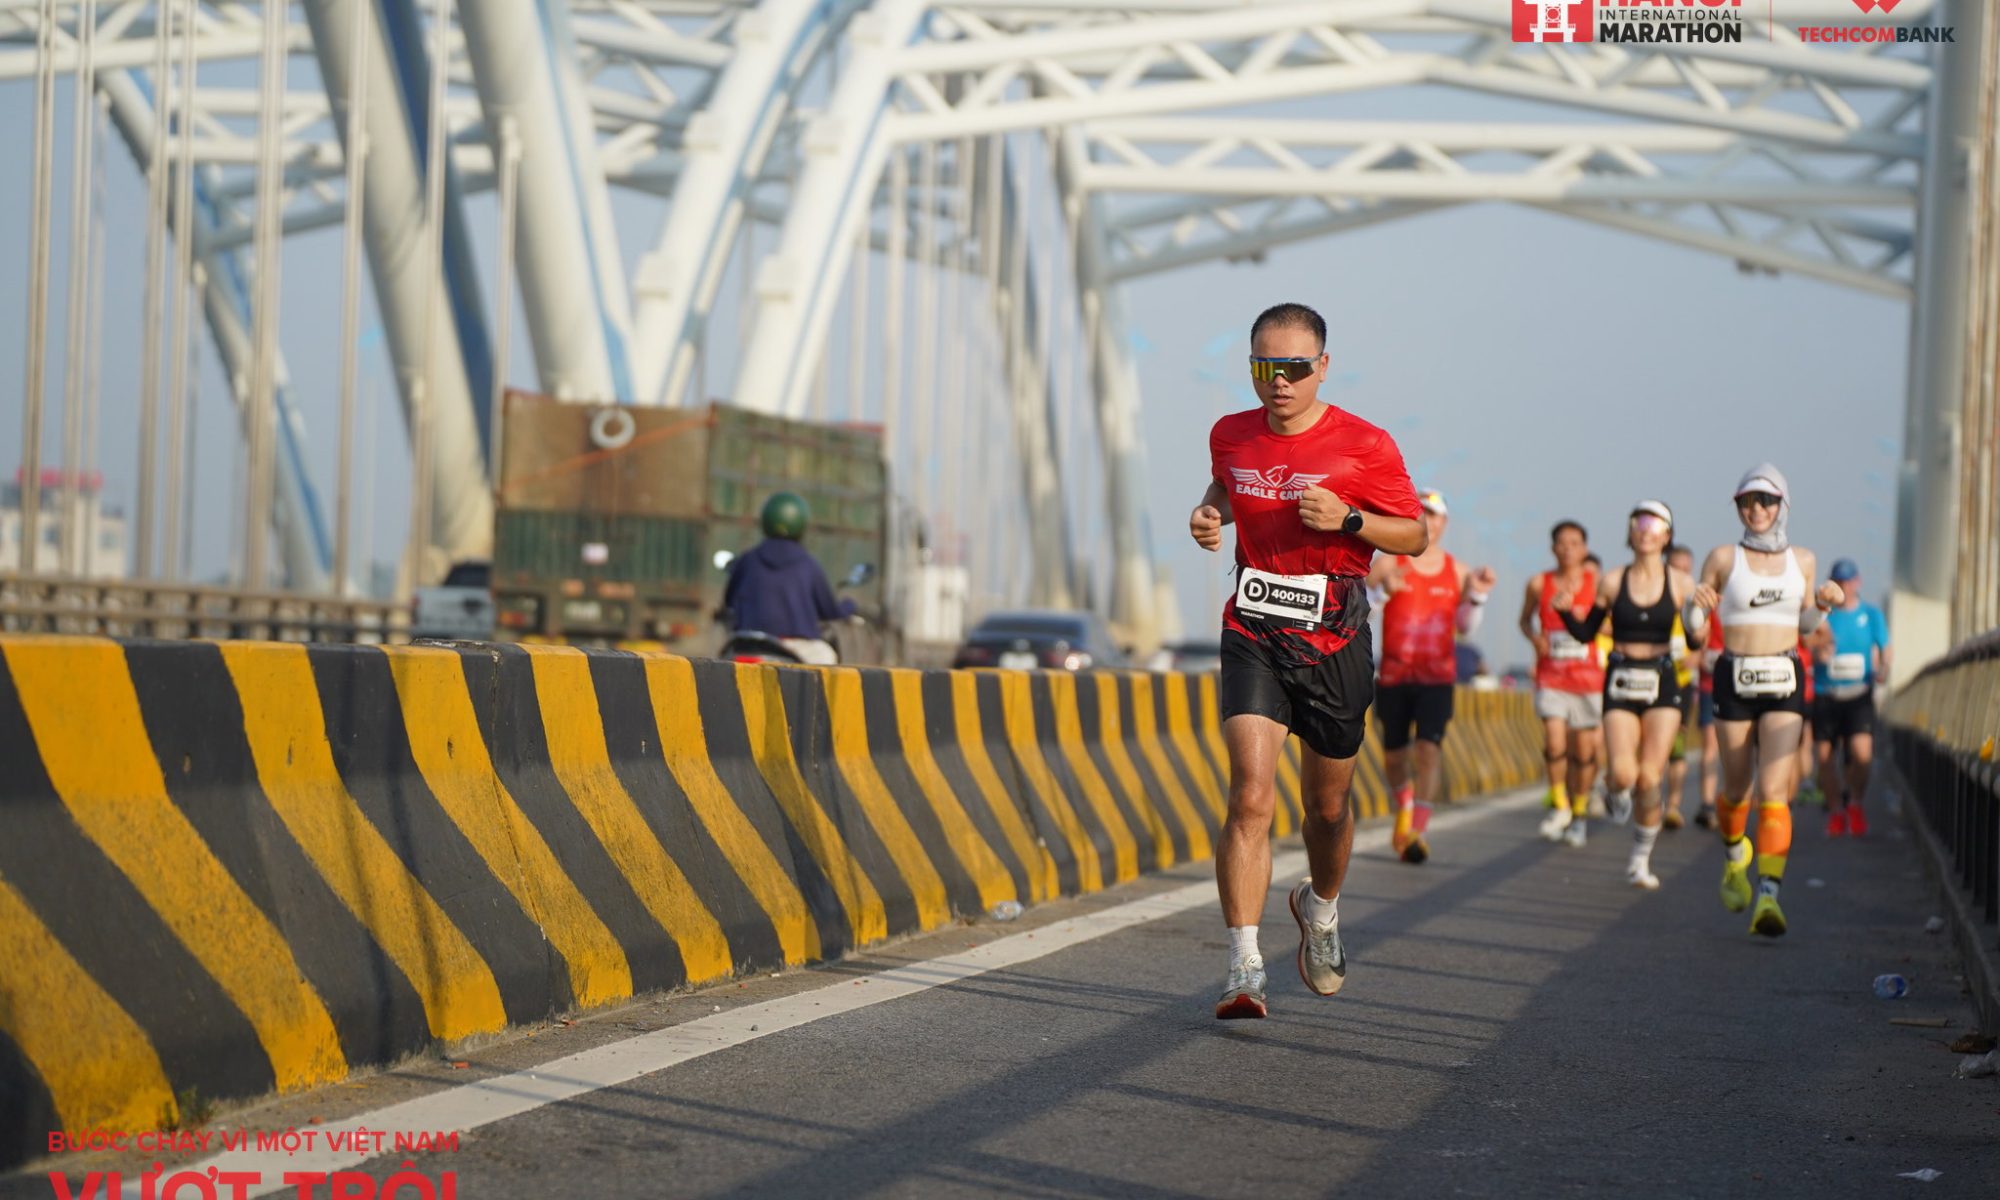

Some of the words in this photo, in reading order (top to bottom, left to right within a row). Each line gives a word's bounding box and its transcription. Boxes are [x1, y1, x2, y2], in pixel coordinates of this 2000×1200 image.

[1235, 484, 1277, 500] EAGLE
[1279, 489, 1304, 501] CAM
[1248, 581, 1263, 598] D
[1271, 588, 1316, 605] 400133
